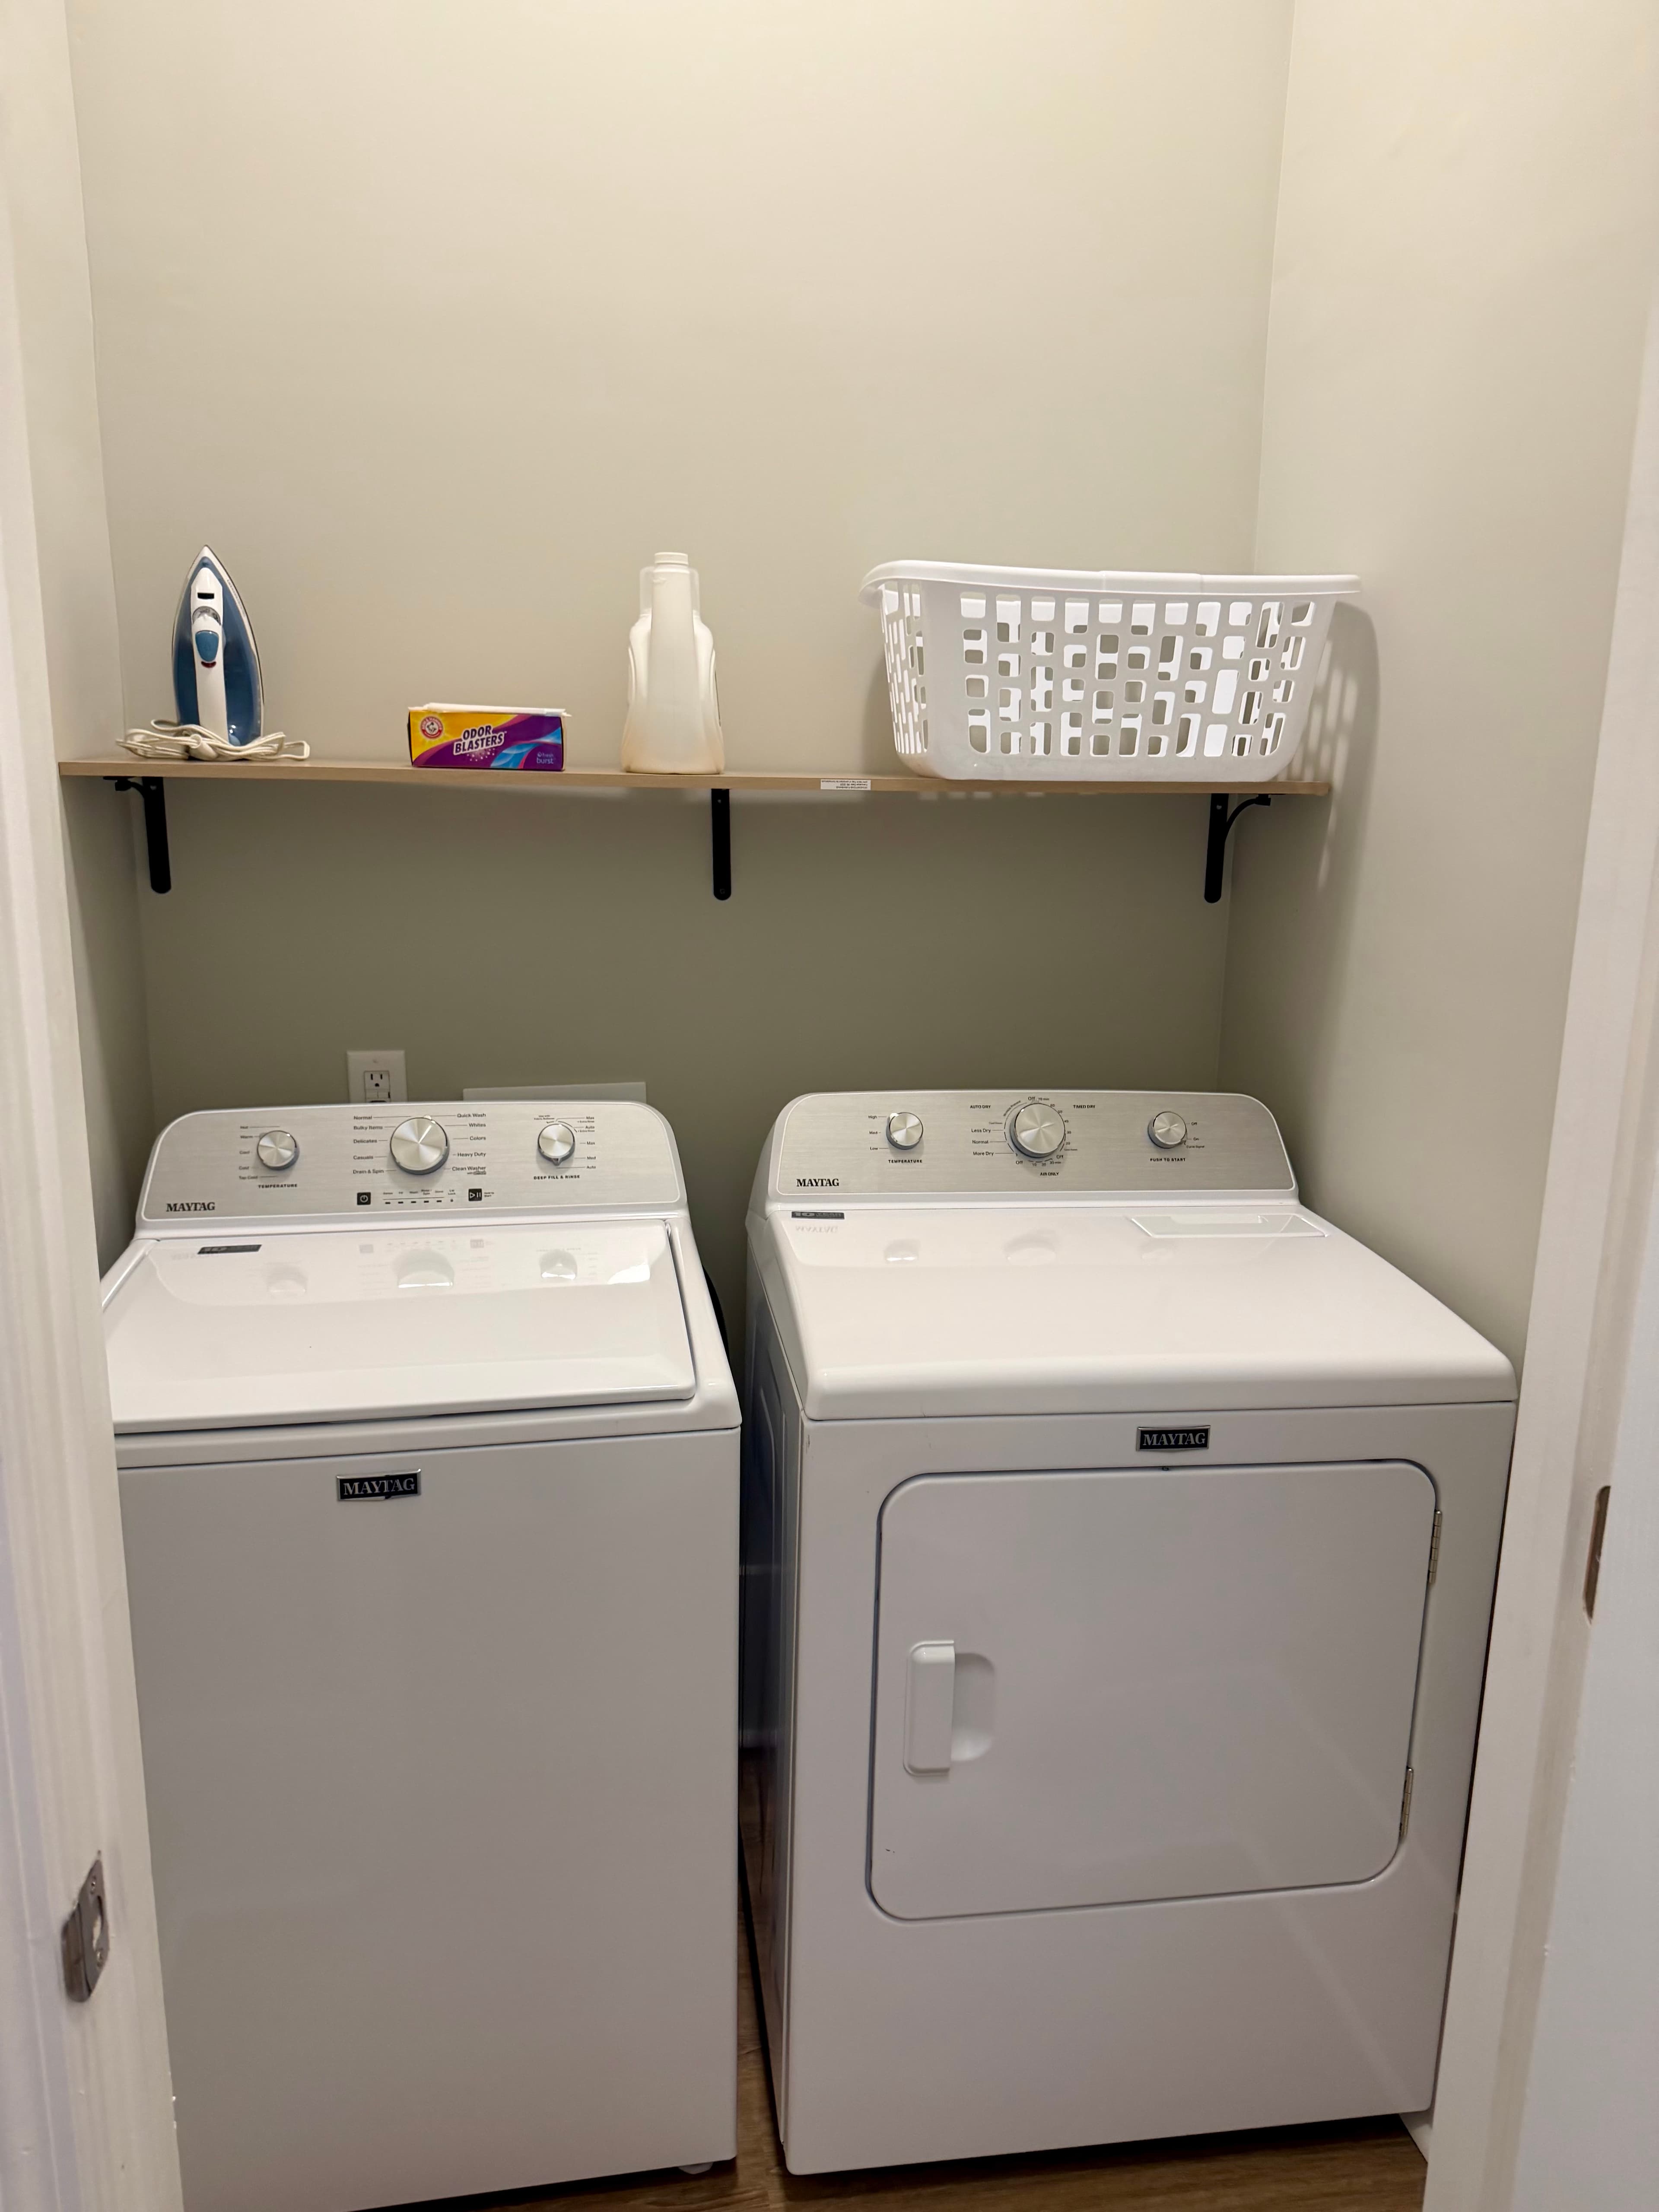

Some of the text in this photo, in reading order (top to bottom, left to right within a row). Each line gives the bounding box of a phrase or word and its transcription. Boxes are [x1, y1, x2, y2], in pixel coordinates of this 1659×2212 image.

[463, 725, 492, 741] ODOR
[455, 734, 504, 753] BLASTERS
[796, 1178, 839, 1187] MAYTAG
[166, 1202, 216, 1212] MAYTAG
[1143, 1433, 1206, 1446] MAYTAG
[343, 1478, 415, 1495] MAYTAG
